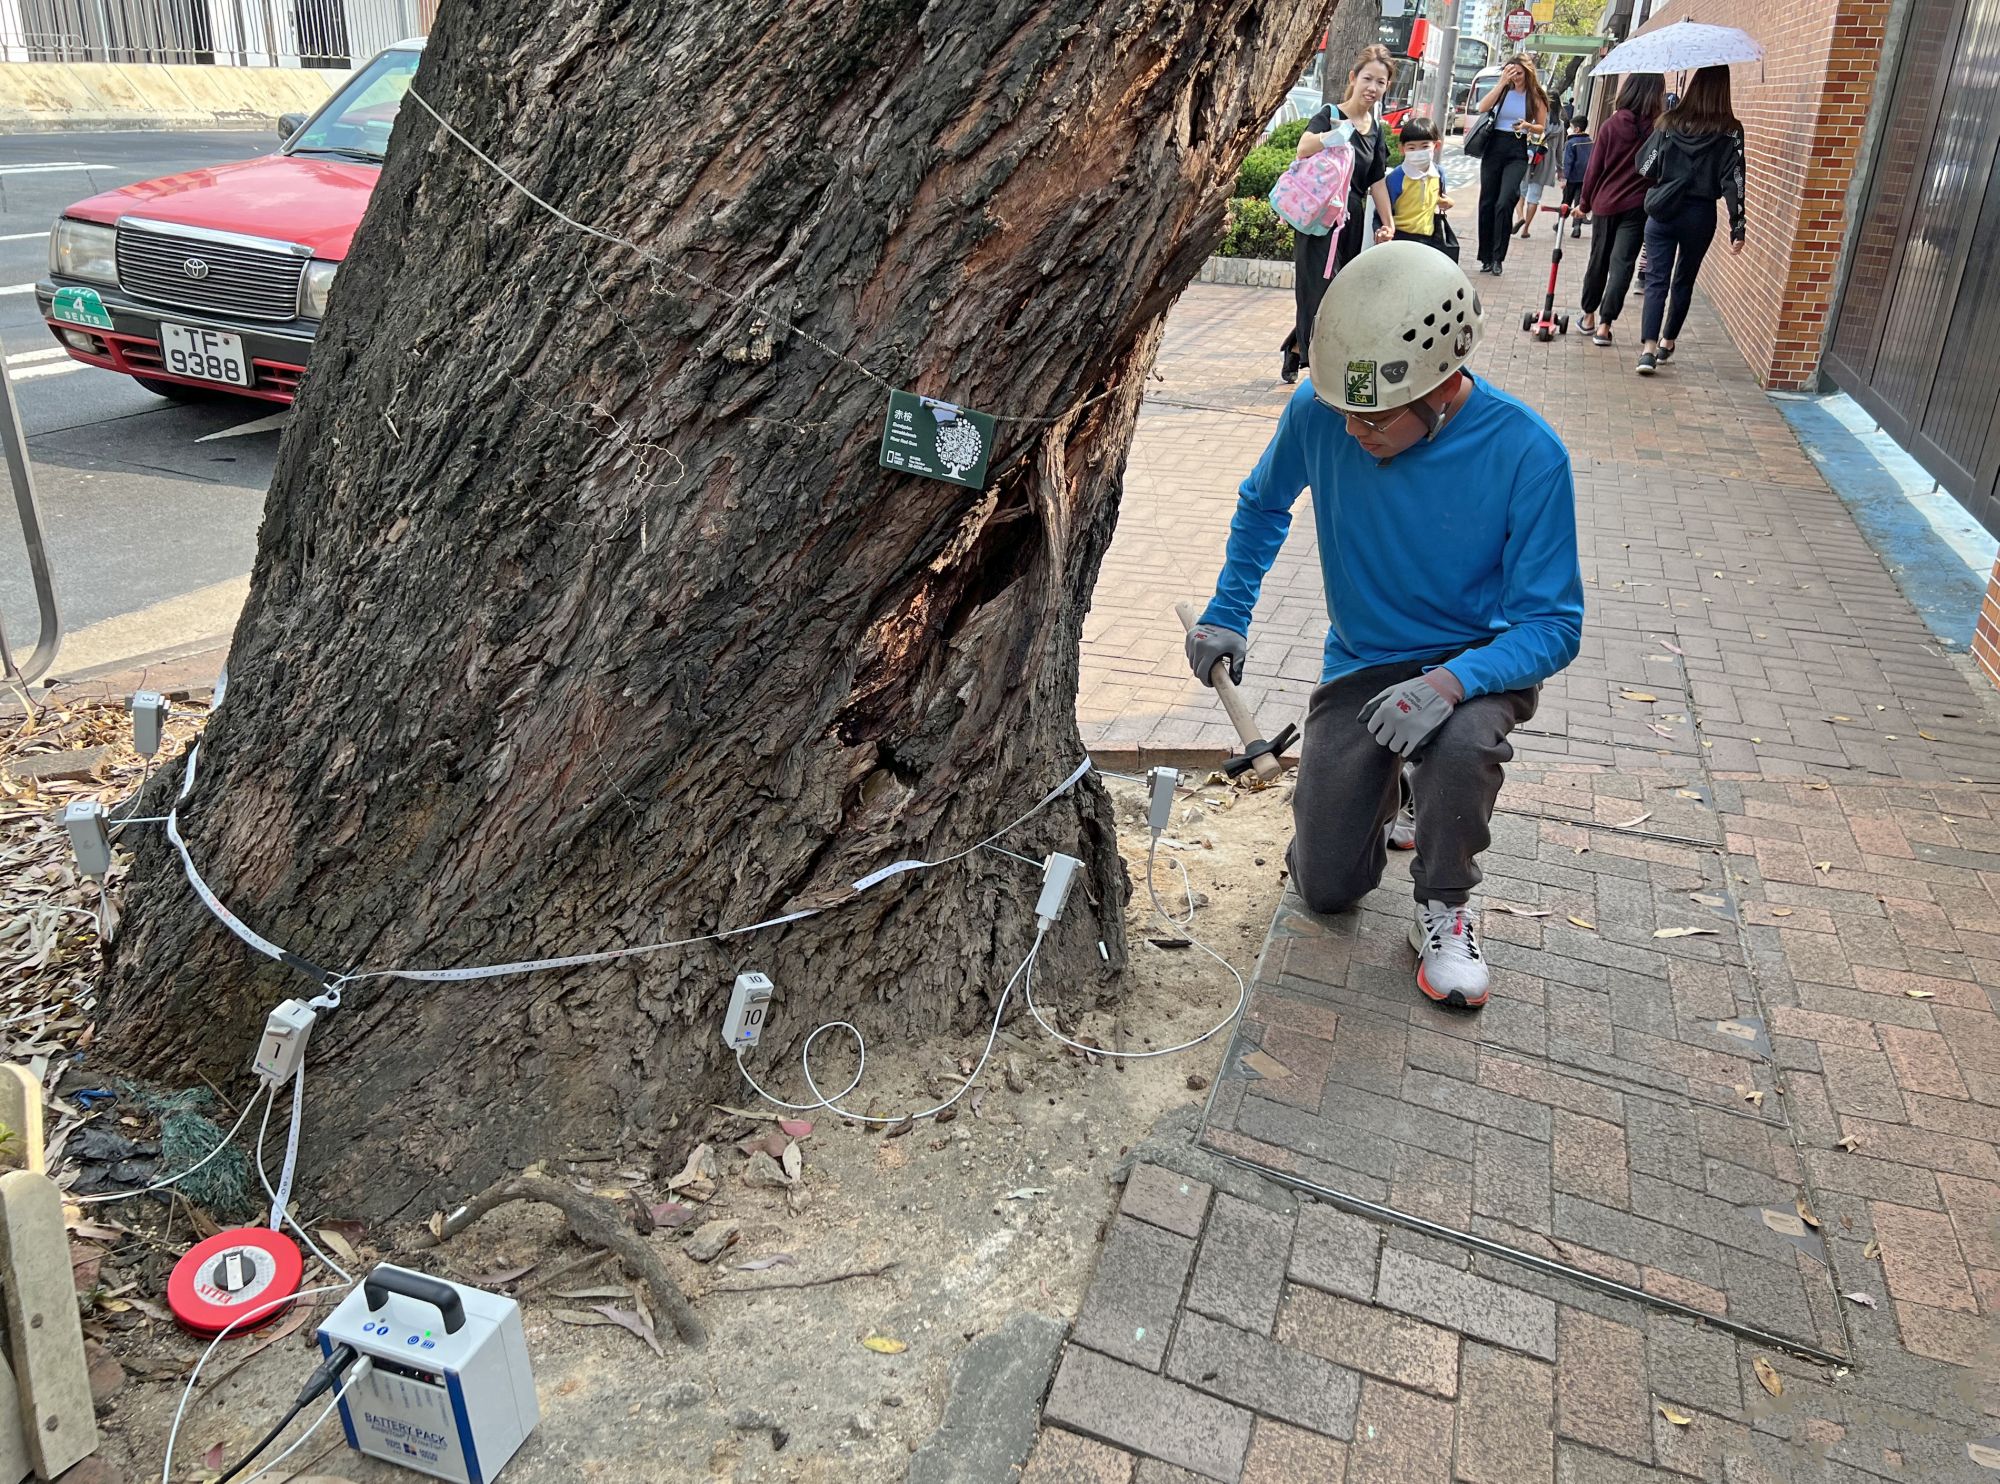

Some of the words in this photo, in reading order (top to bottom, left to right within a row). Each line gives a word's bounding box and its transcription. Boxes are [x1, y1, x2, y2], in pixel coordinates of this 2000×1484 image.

[73, 297, 85, 312] 4
[65, 311, 100, 324] SEATS
[184, 328, 218, 354] TF
[171, 349, 240, 381] 9388
[748, 975, 763, 984] 10
[292, 1008, 301, 1016] 1
[744, 1009, 763, 1027] 10
[275, 1042, 282, 1060] 1
[364, 1412, 412, 1436] BATTERY
[415, 1428, 445, 1445] PACK
